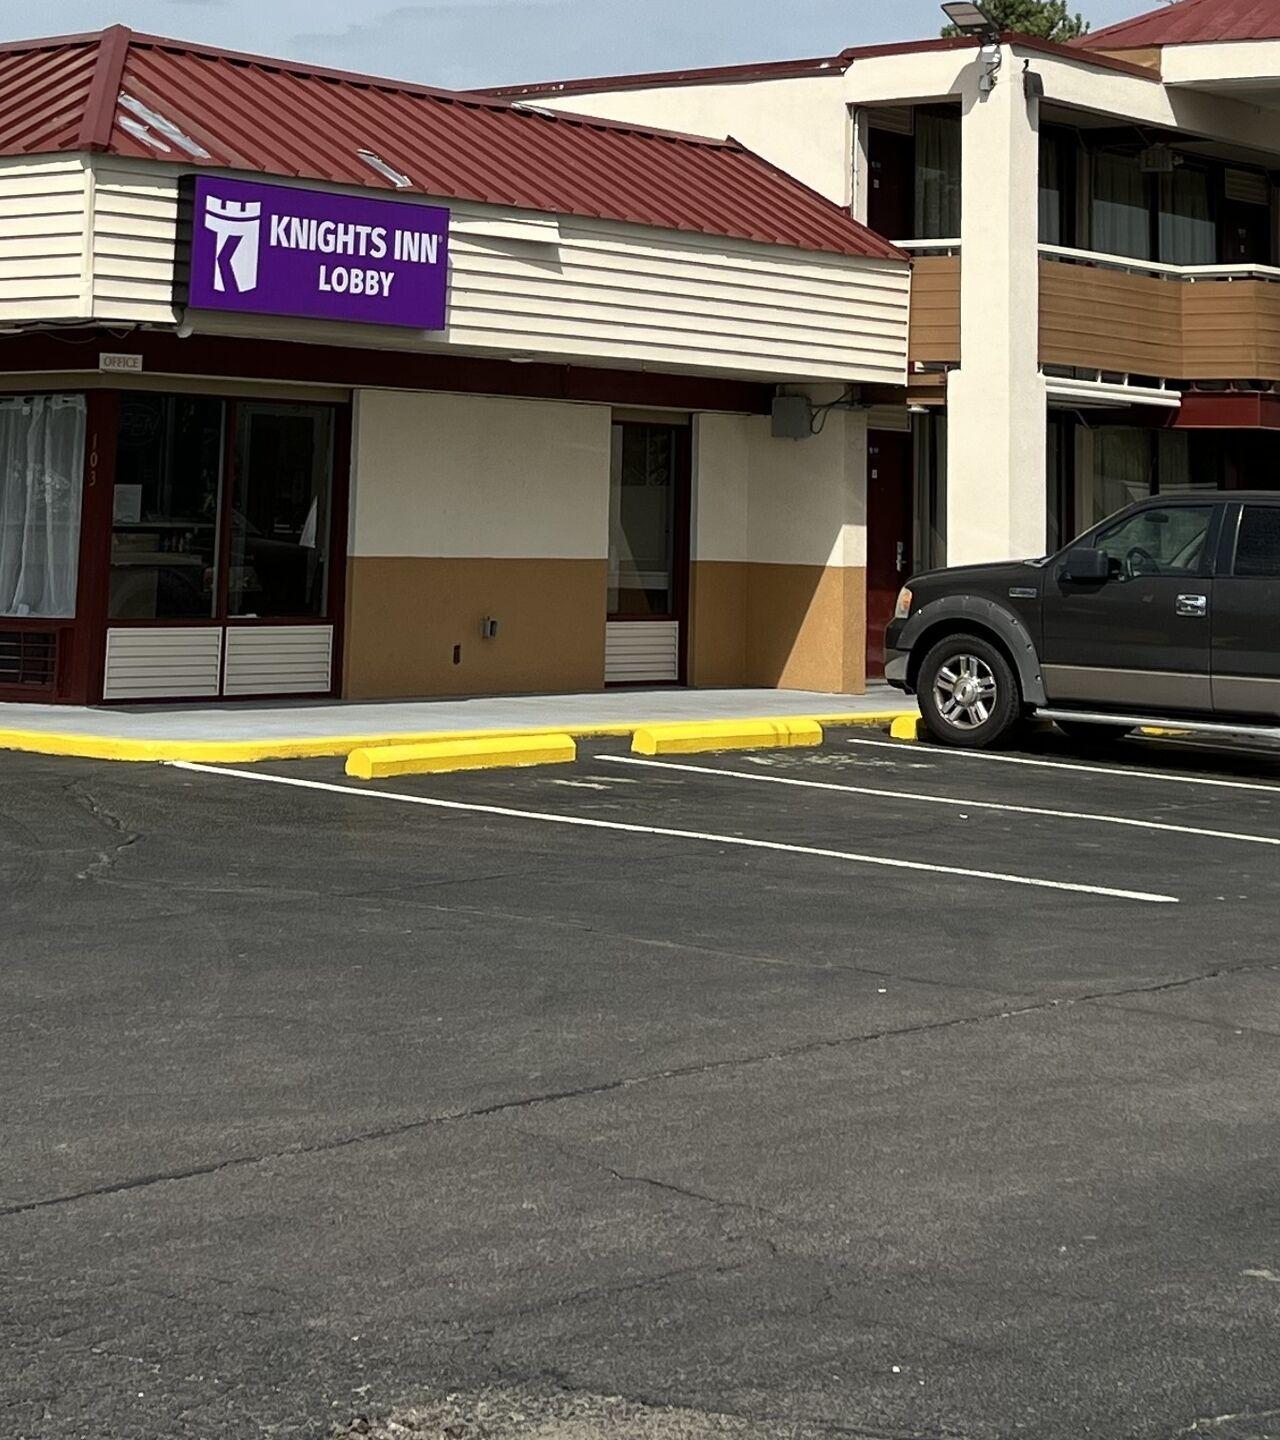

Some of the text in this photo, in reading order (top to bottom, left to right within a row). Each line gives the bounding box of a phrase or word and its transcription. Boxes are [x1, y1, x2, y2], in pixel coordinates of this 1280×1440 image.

[270, 214, 438, 264] KNIGHTS INN
[318, 265, 395, 297] LOBBY
[103, 355, 139, 368] OFFICE
[89, 432, 98, 487] 103
